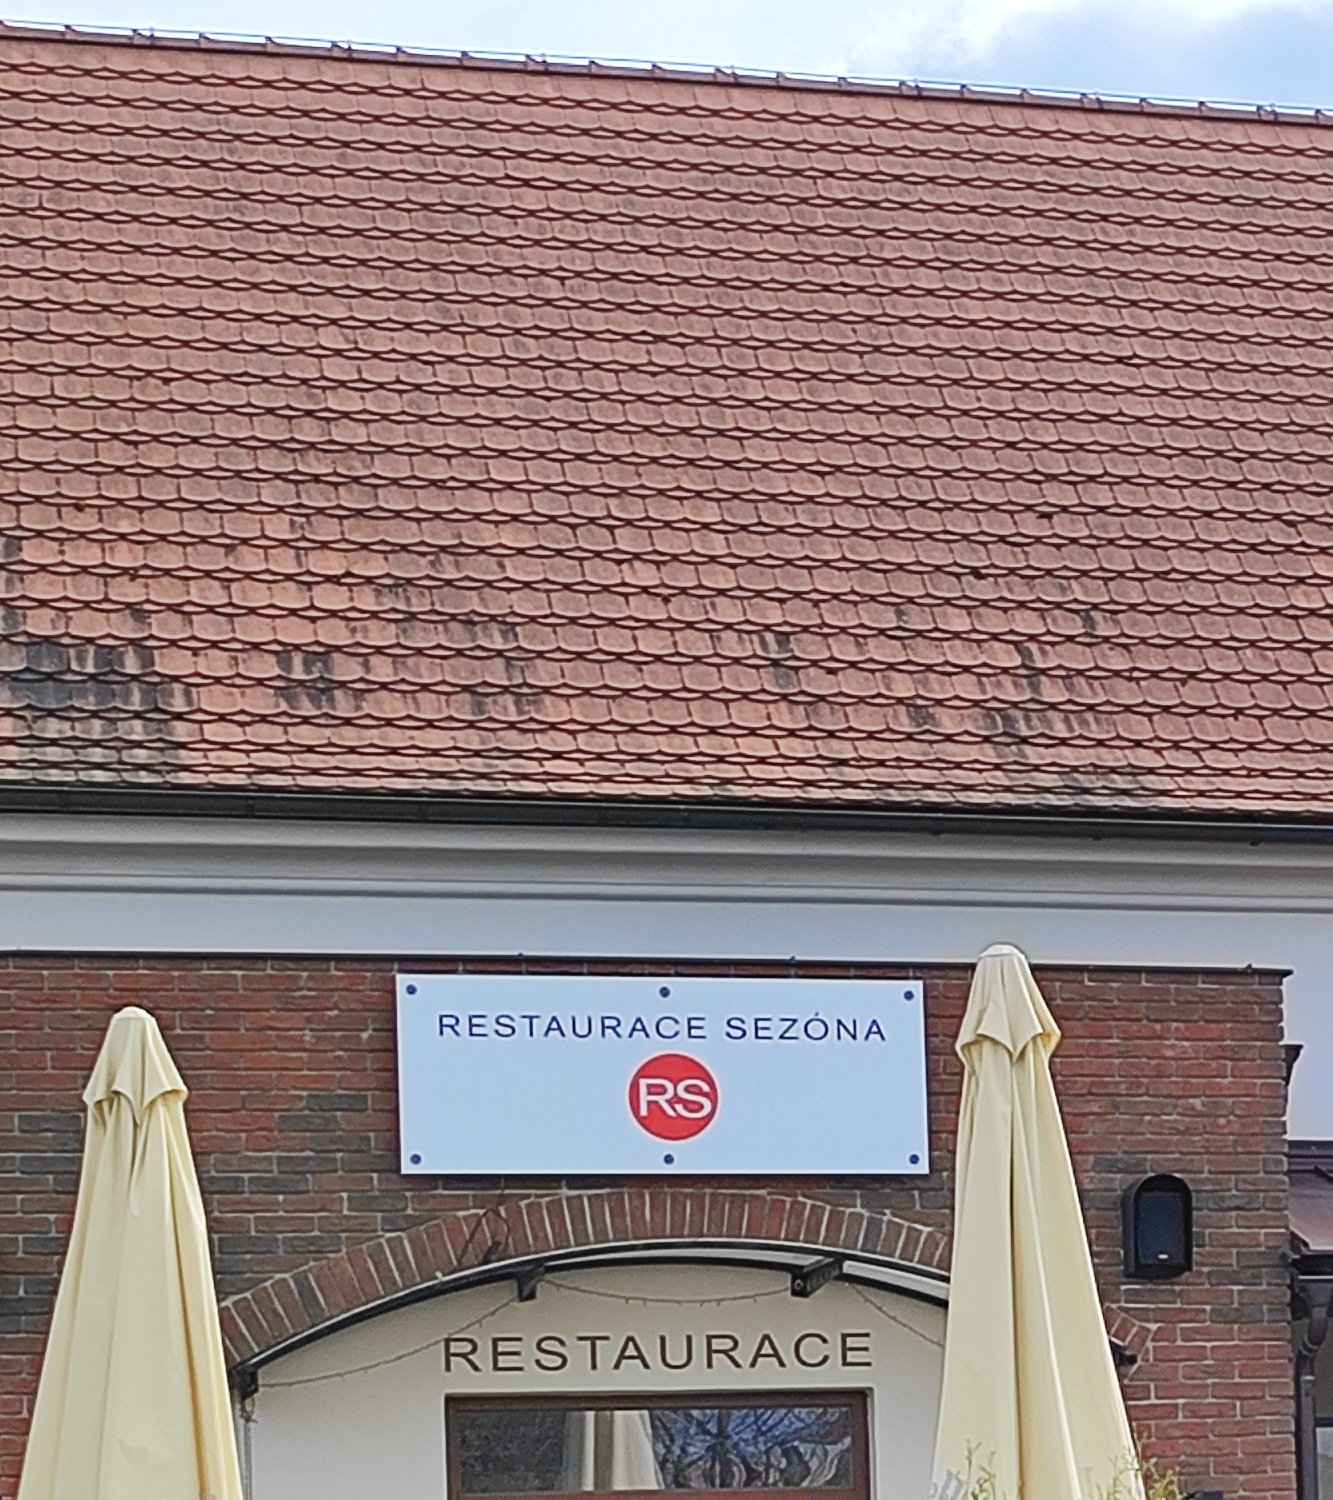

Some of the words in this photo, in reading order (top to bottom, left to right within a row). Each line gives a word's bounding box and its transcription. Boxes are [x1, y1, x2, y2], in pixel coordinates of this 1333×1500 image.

[438, 1014, 707, 1040] RESTAURACE
[725, 1011, 886, 1041] SEZÓNA
[638, 1077, 712, 1119] RS
[443, 1331, 872, 1373] RESTAURACE
